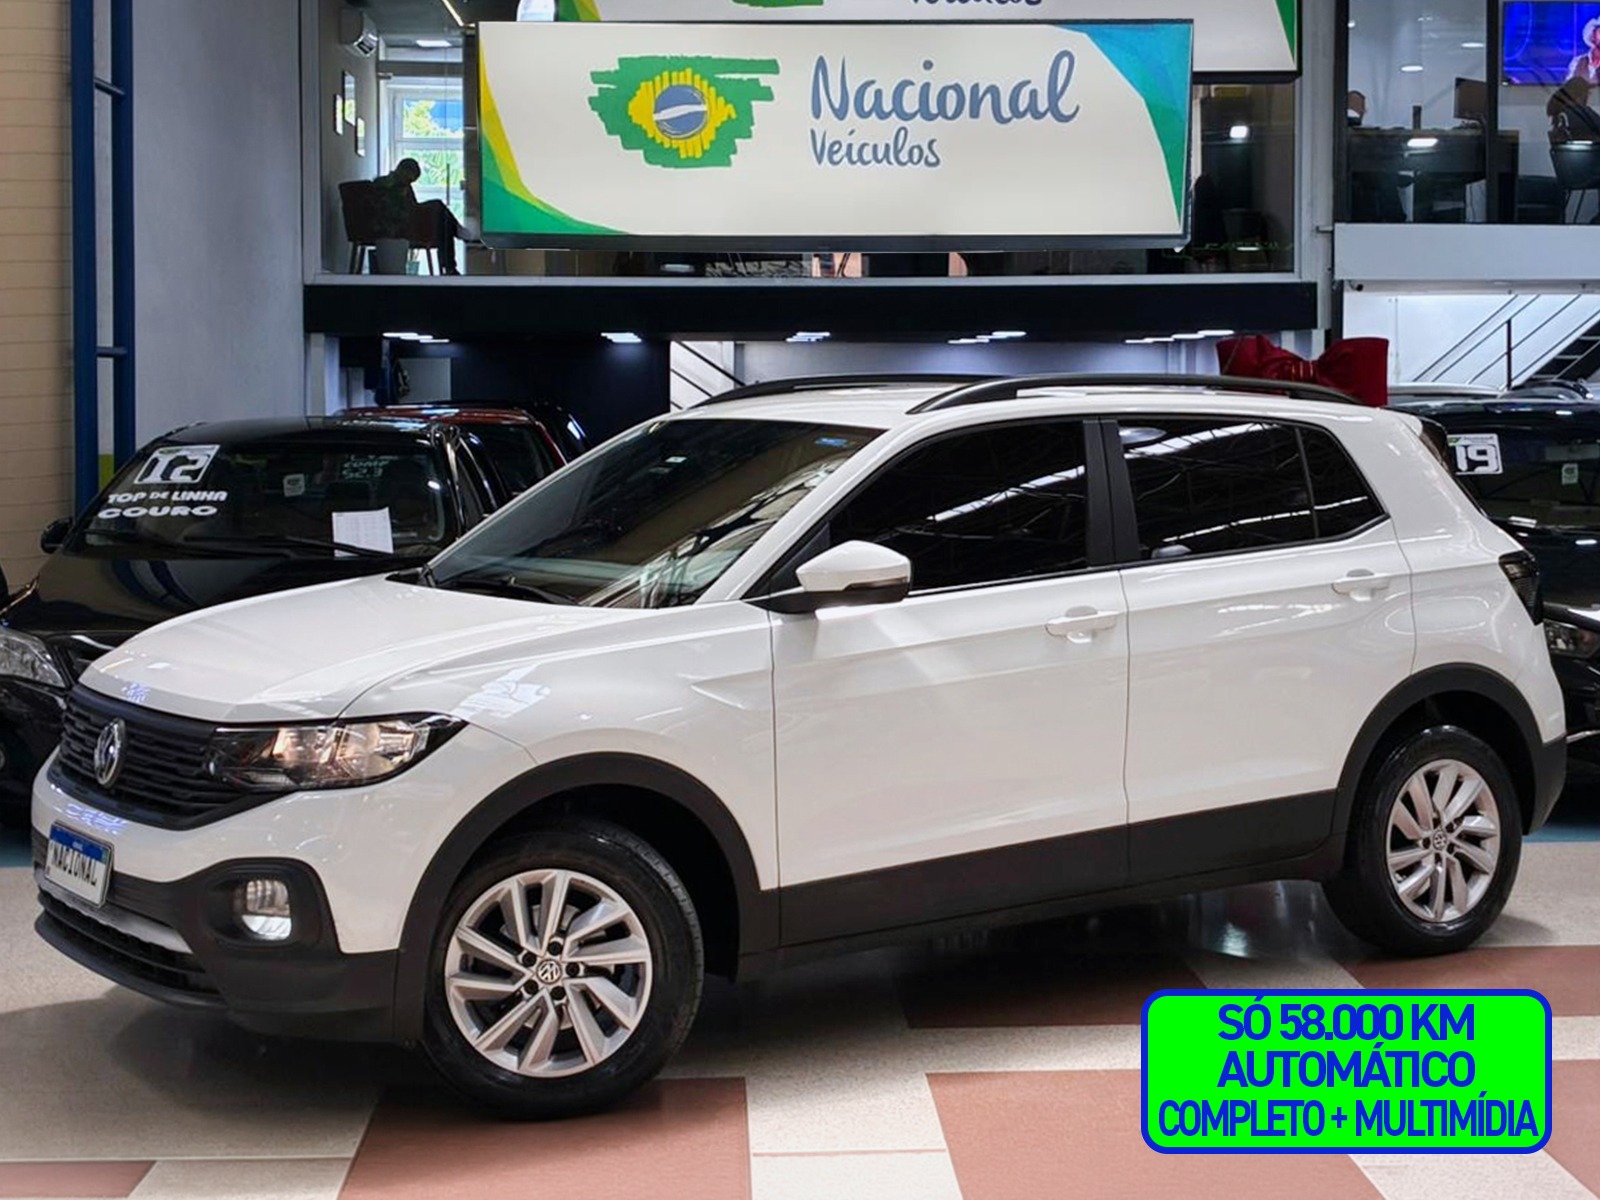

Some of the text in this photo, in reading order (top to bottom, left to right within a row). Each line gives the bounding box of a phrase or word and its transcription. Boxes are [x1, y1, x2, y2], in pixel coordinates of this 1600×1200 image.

[811, 50, 1081, 125] Nacional
[810, 126, 941, 168] Veículos
[142, 452, 210, 483] 12
[1454, 443, 1500, 472] 19
[97, 505, 218, 519] COURO
[107, 490, 228, 504] TOP DE LINHA
[50, 842, 98, 888] NACIONAL
